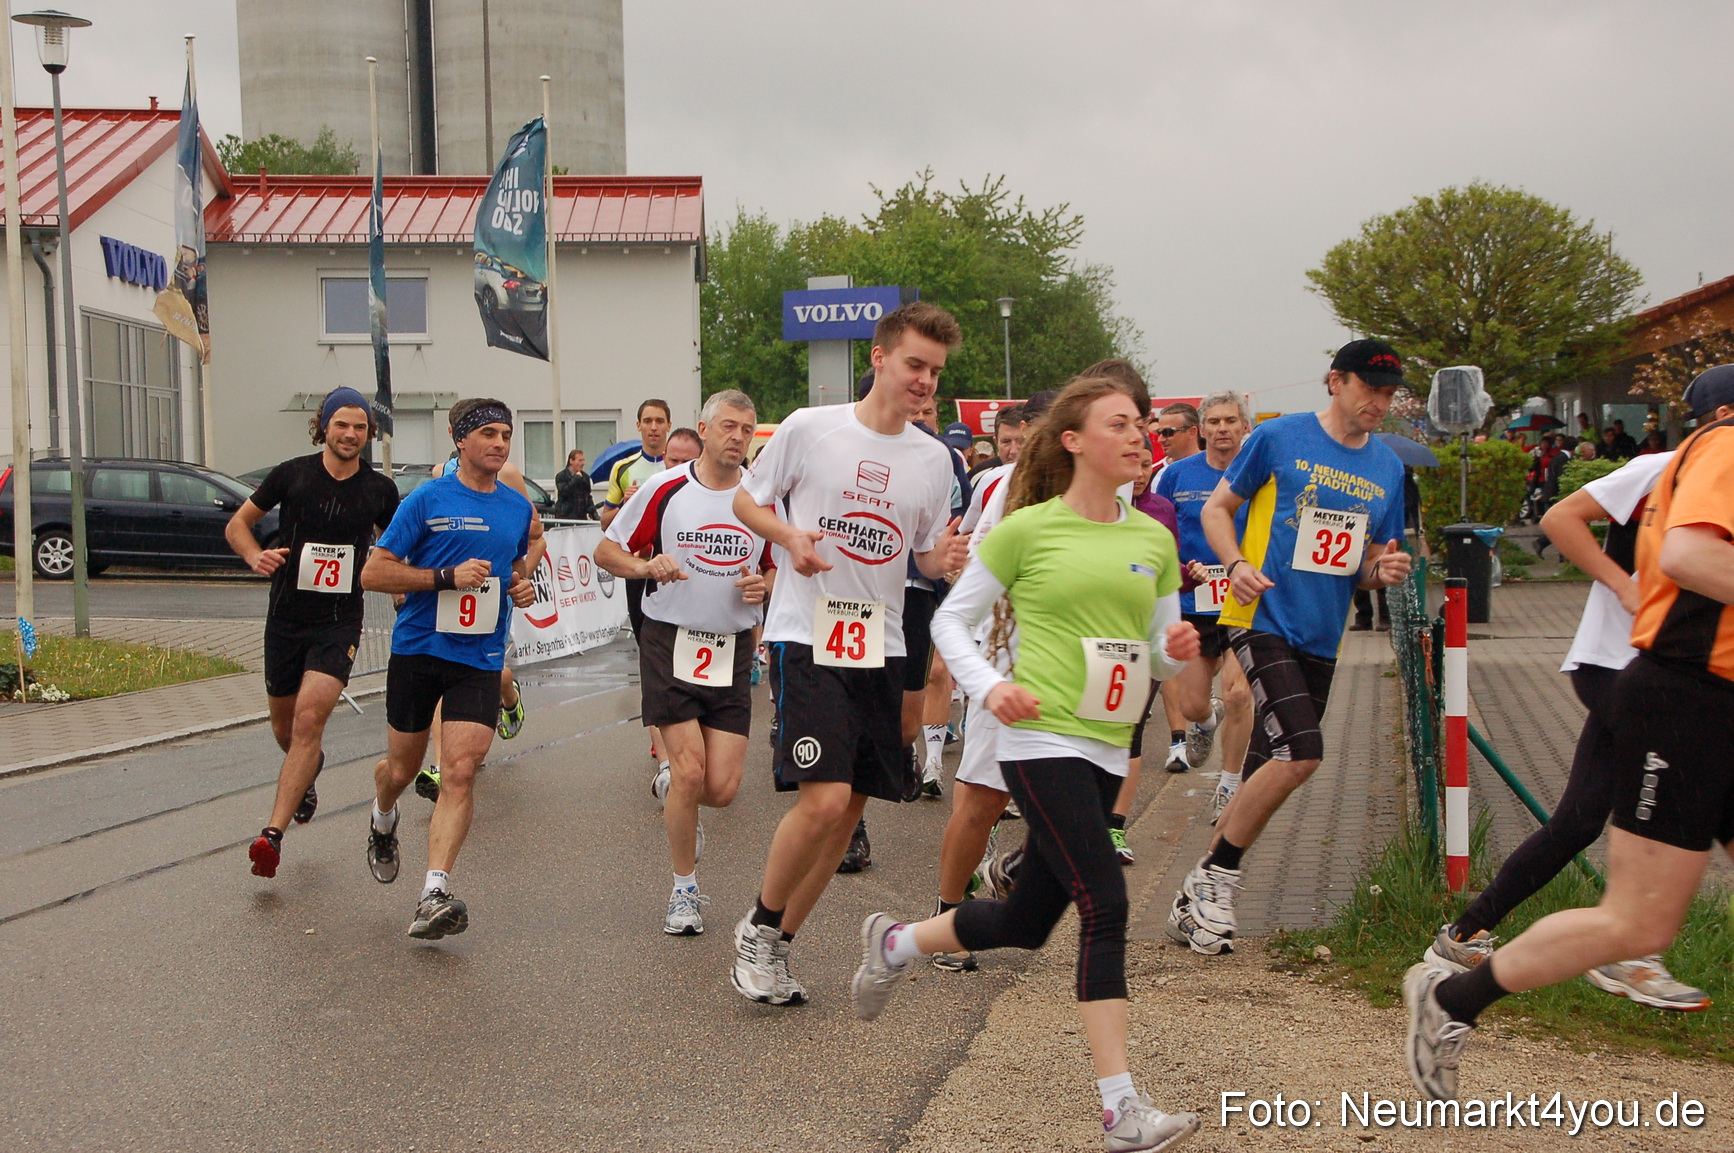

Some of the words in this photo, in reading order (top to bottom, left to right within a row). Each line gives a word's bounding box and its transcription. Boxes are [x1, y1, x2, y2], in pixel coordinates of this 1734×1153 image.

[99, 235, 168, 291] VOLVO
[793, 302, 883, 323] VOLVO
[1295, 459, 1312, 472] 10.
[1313, 463, 1385, 499] NEUMARKTER
[1309, 473, 1374, 502] STADTLAUF
[842, 490, 895, 510] SEAT
[1313, 511, 1344, 521] MEYER
[677, 531, 741, 545] GERHART
[819, 516, 887, 541] GERHART
[887, 533, 894, 541] &
[311, 546, 336, 554] MEYER
[705, 544, 748, 557] JÄNIG
[848, 536, 893, 556] JÄNIG
[1311, 529, 1352, 568] 32
[313, 559, 341, 587] 73
[685, 558, 695, 569] Das
[695, 565, 726, 577] sportliche
[1209, 578, 1231, 605] 13
[459, 594, 477, 627] 9
[827, 600, 859, 610] MEYER
[827, 608, 859, 617] WERBUNG
[687, 629, 716, 640] MEYER
[826, 620, 866, 660] 43
[693, 647, 713, 679] 2
[1105, 664, 1127, 711] 6
[797, 743, 814, 763] 90
